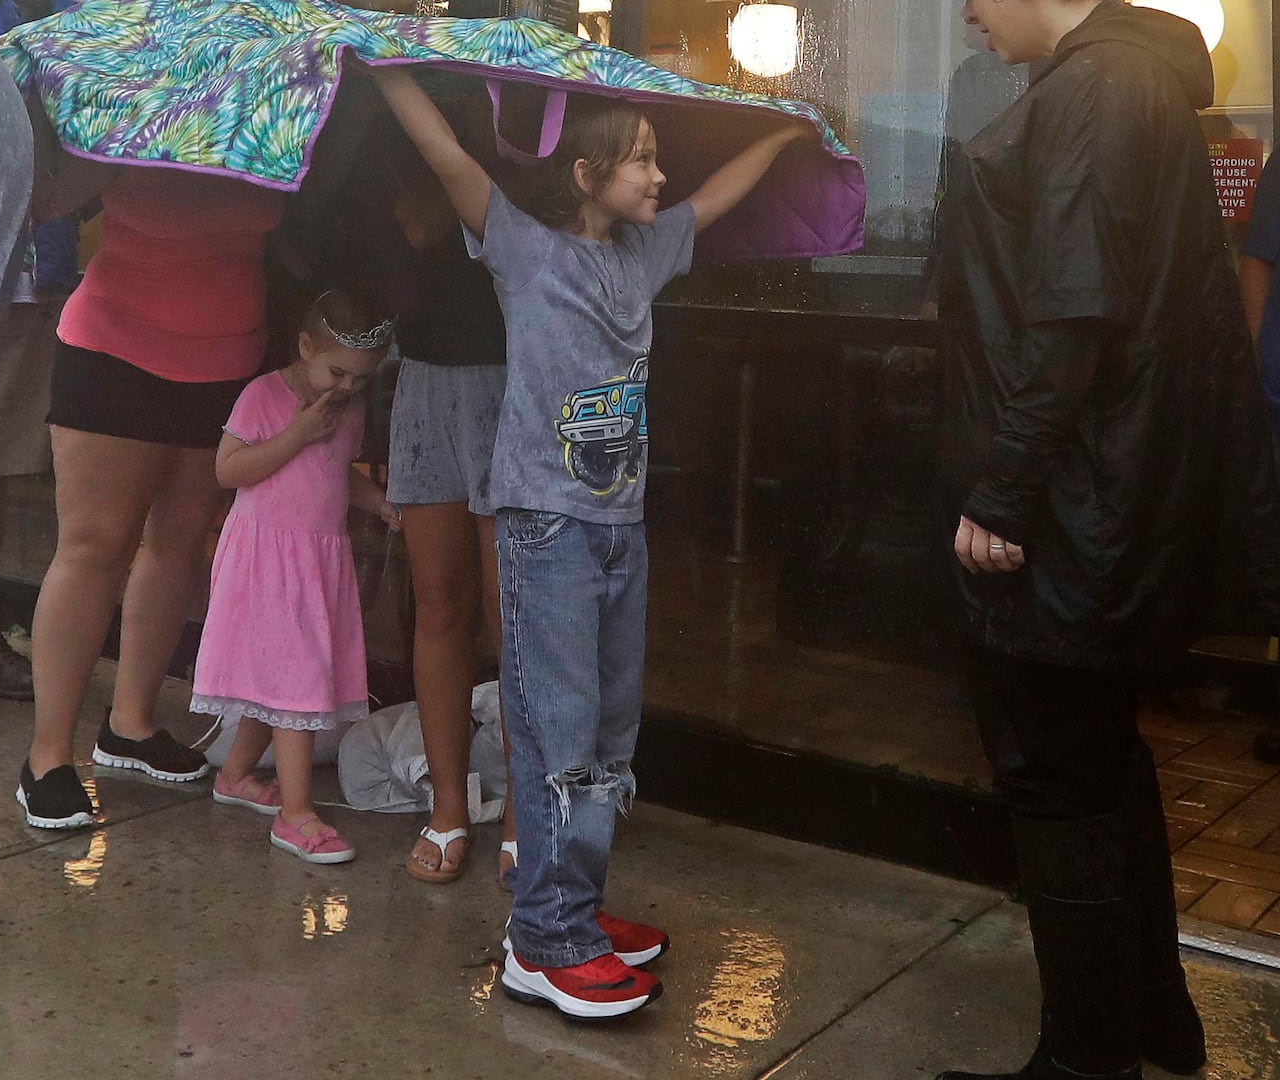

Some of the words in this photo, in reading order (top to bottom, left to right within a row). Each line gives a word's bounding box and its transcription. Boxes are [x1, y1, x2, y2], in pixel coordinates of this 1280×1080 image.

[1213, 168, 1223, 177] IN
[1226, 168, 1247, 177] USE
[1222, 189, 1244, 197] AND
